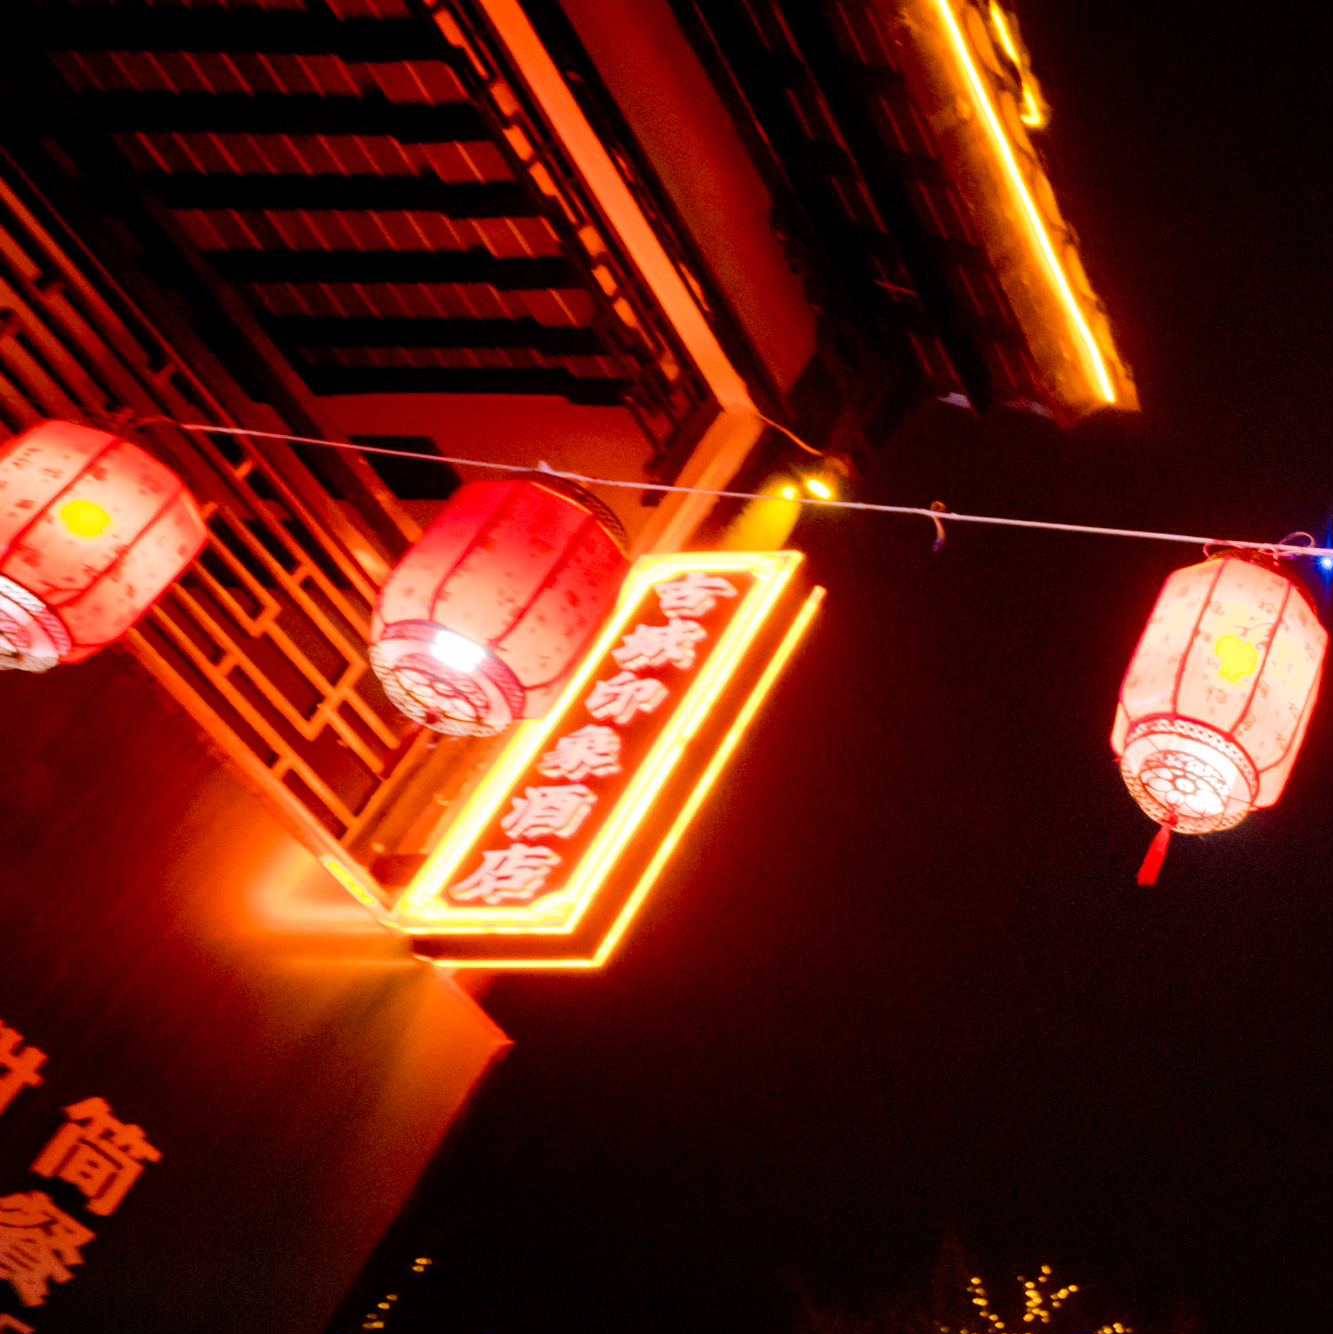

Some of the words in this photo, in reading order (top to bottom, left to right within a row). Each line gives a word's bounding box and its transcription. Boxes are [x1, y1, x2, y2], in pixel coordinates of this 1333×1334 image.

[450, 571, 738, 904] 古城印象酒店
